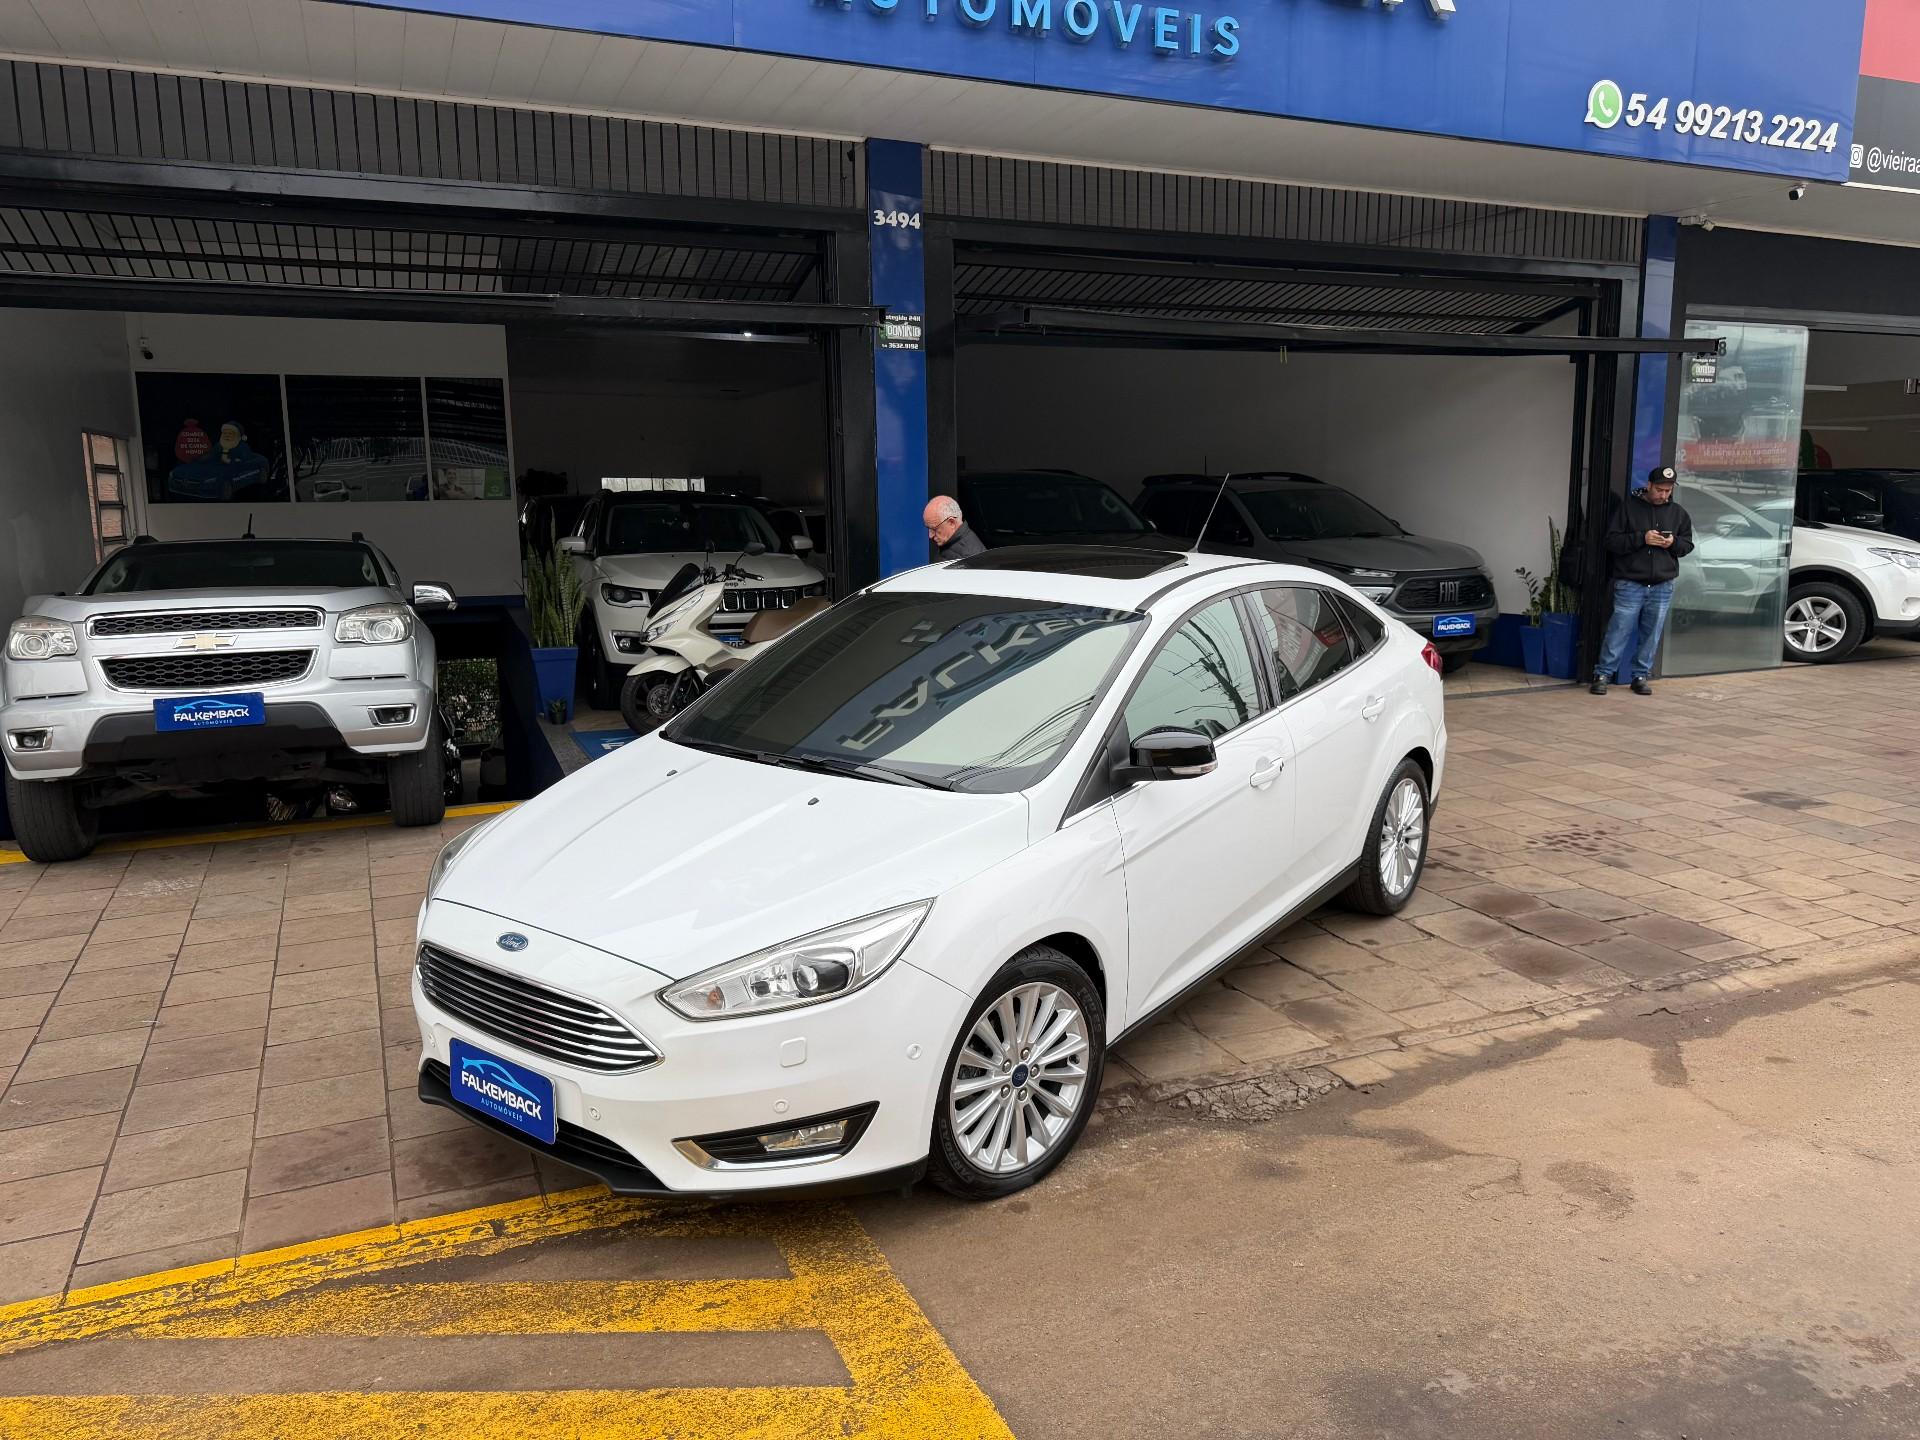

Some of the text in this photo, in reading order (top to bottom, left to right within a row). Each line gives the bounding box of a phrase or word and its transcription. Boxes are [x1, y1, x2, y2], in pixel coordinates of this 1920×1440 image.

[844, 0, 1240, 57] OMOVEIS
[1626, 93, 1839, 153] 54 99213.2224
[873, 210, 920, 230] 3494
[1439, 581, 1460, 604] FIAT
[173, 708, 250, 722] FALKEMBACK
[501, 936, 522, 948] Ford
[461, 1070, 542, 1121] FALKEMBACK
[480, 1096, 523, 1123] AUTOMÓVEIS
